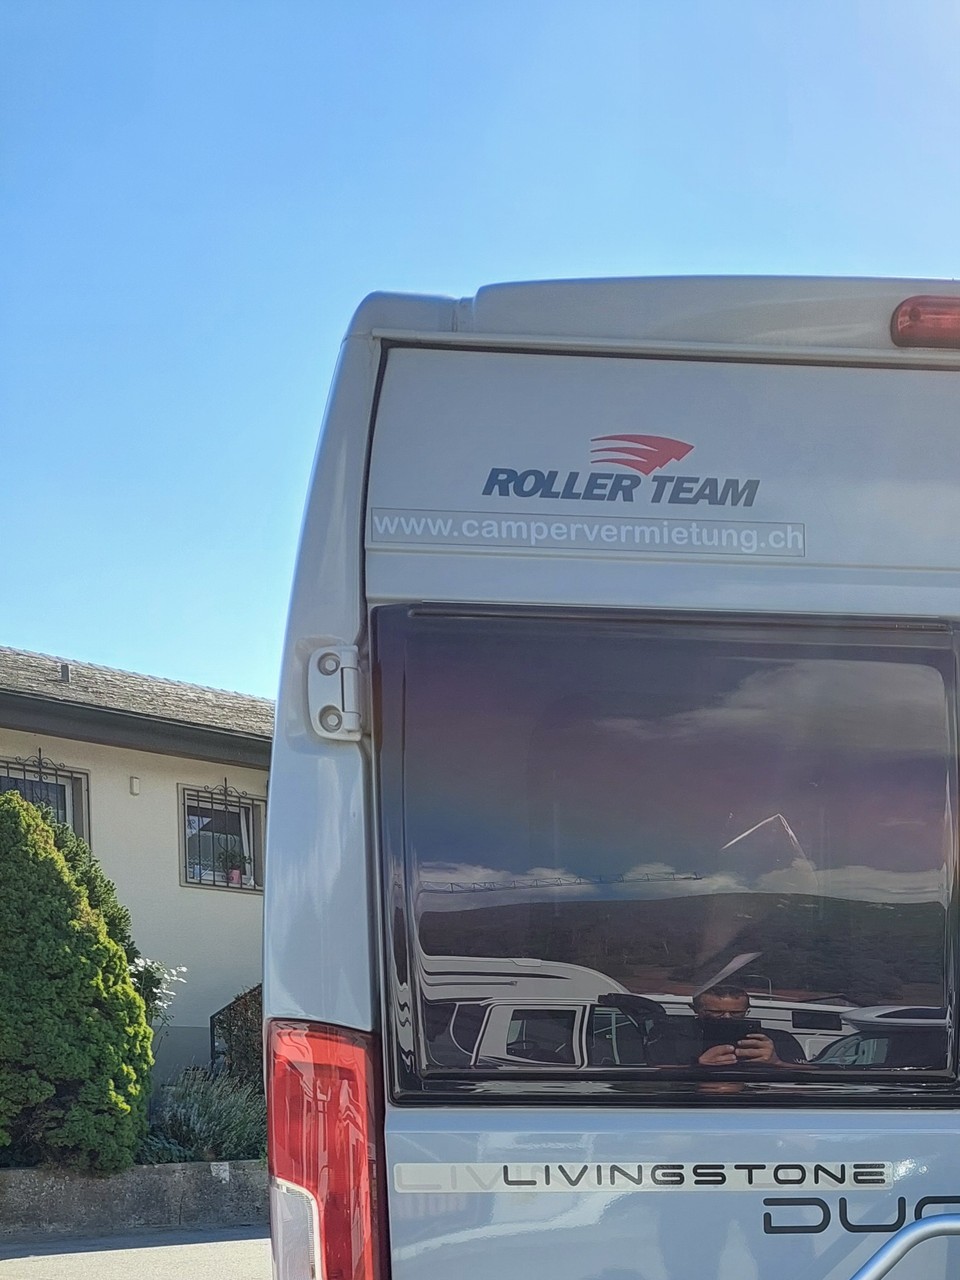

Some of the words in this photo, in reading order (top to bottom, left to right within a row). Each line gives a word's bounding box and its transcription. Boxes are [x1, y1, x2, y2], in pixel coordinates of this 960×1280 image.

[482, 467, 641, 502] ROLLER
[650, 475, 760, 508] TEAM
[373, 514, 804, 554] www.campervermietung.ch
[503, 1163, 886, 1187] LIVINGSTONE
